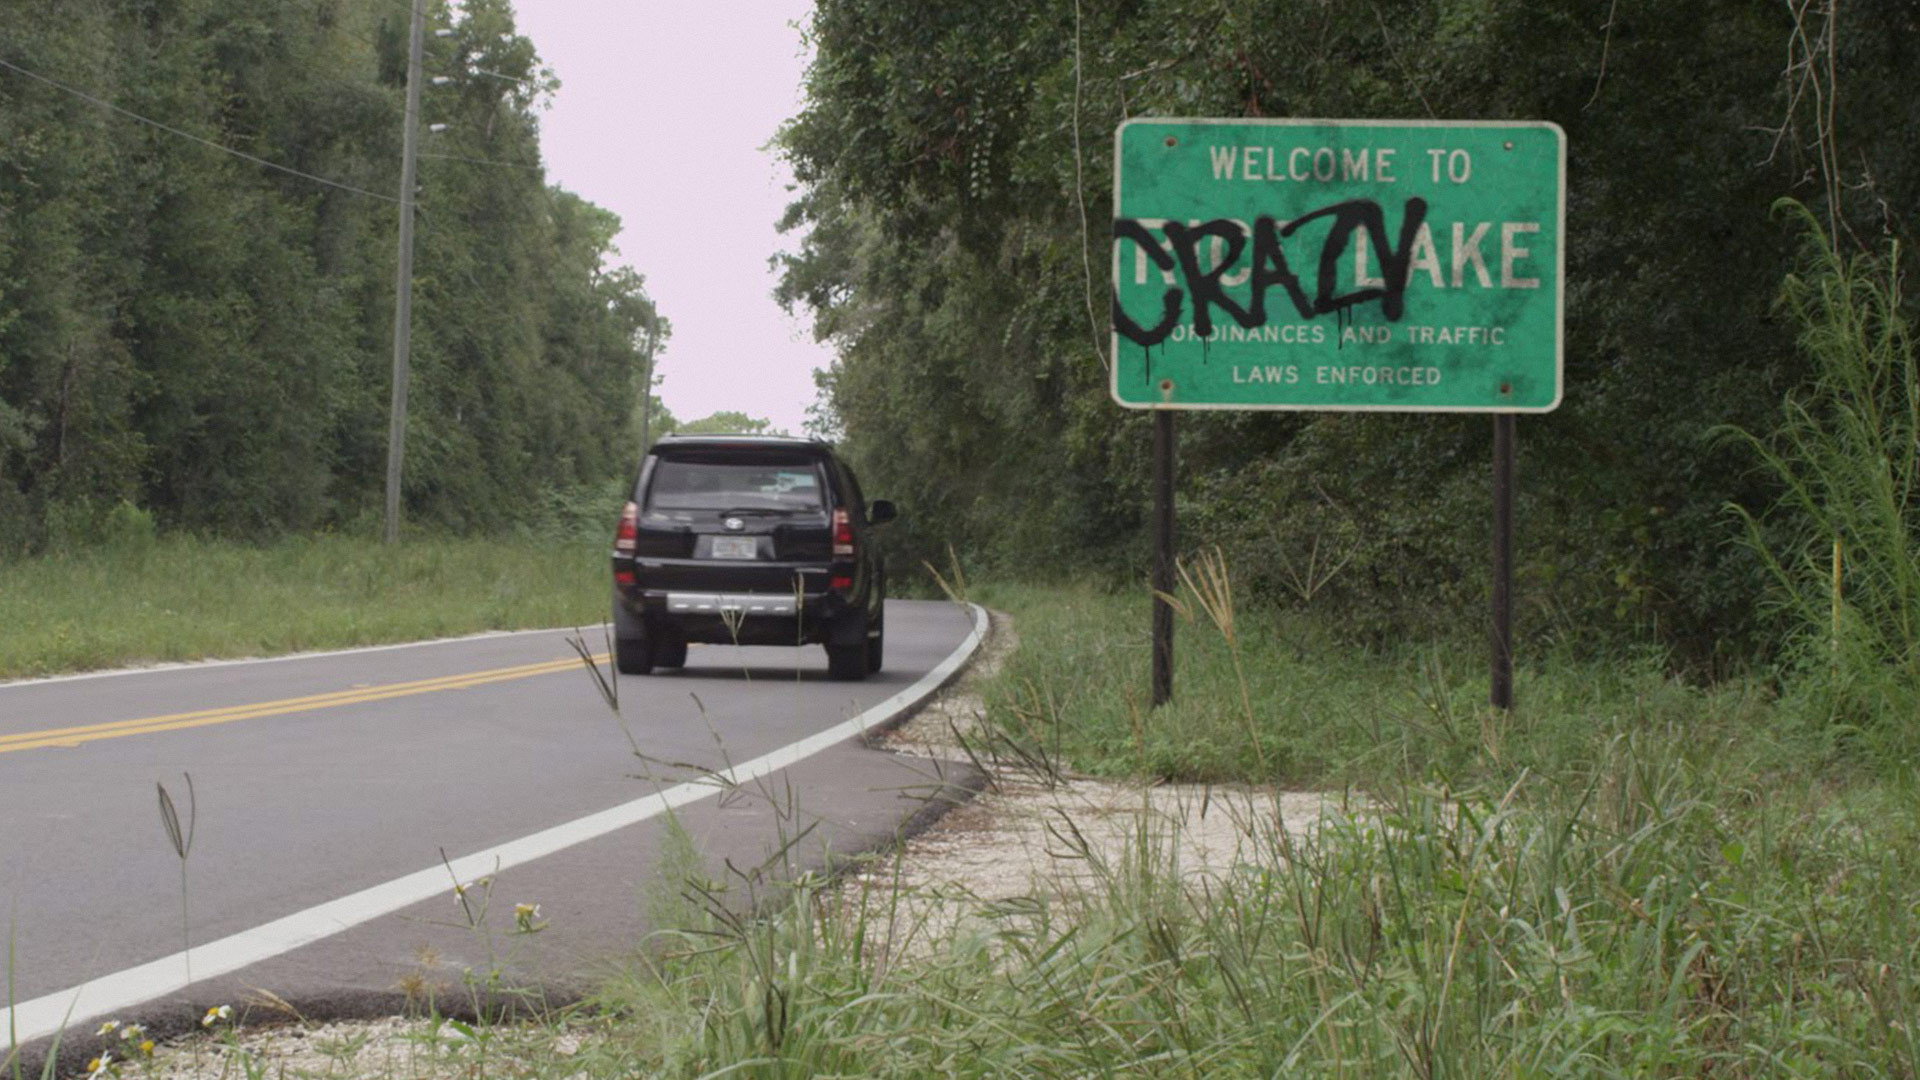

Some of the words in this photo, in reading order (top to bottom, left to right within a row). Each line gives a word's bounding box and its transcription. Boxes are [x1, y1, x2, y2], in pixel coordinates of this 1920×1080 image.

[1210, 145, 1396, 183] WELCOME
[1427, 149, 1472, 183] TO
[1355, 221, 1541, 288] LAKE
[1342, 326, 1392, 344] AND
[1408, 326, 1505, 345] TRAFFIC
[1232, 366, 1299, 384] LAWS
[1316, 367, 1441, 385] ENFORCED
